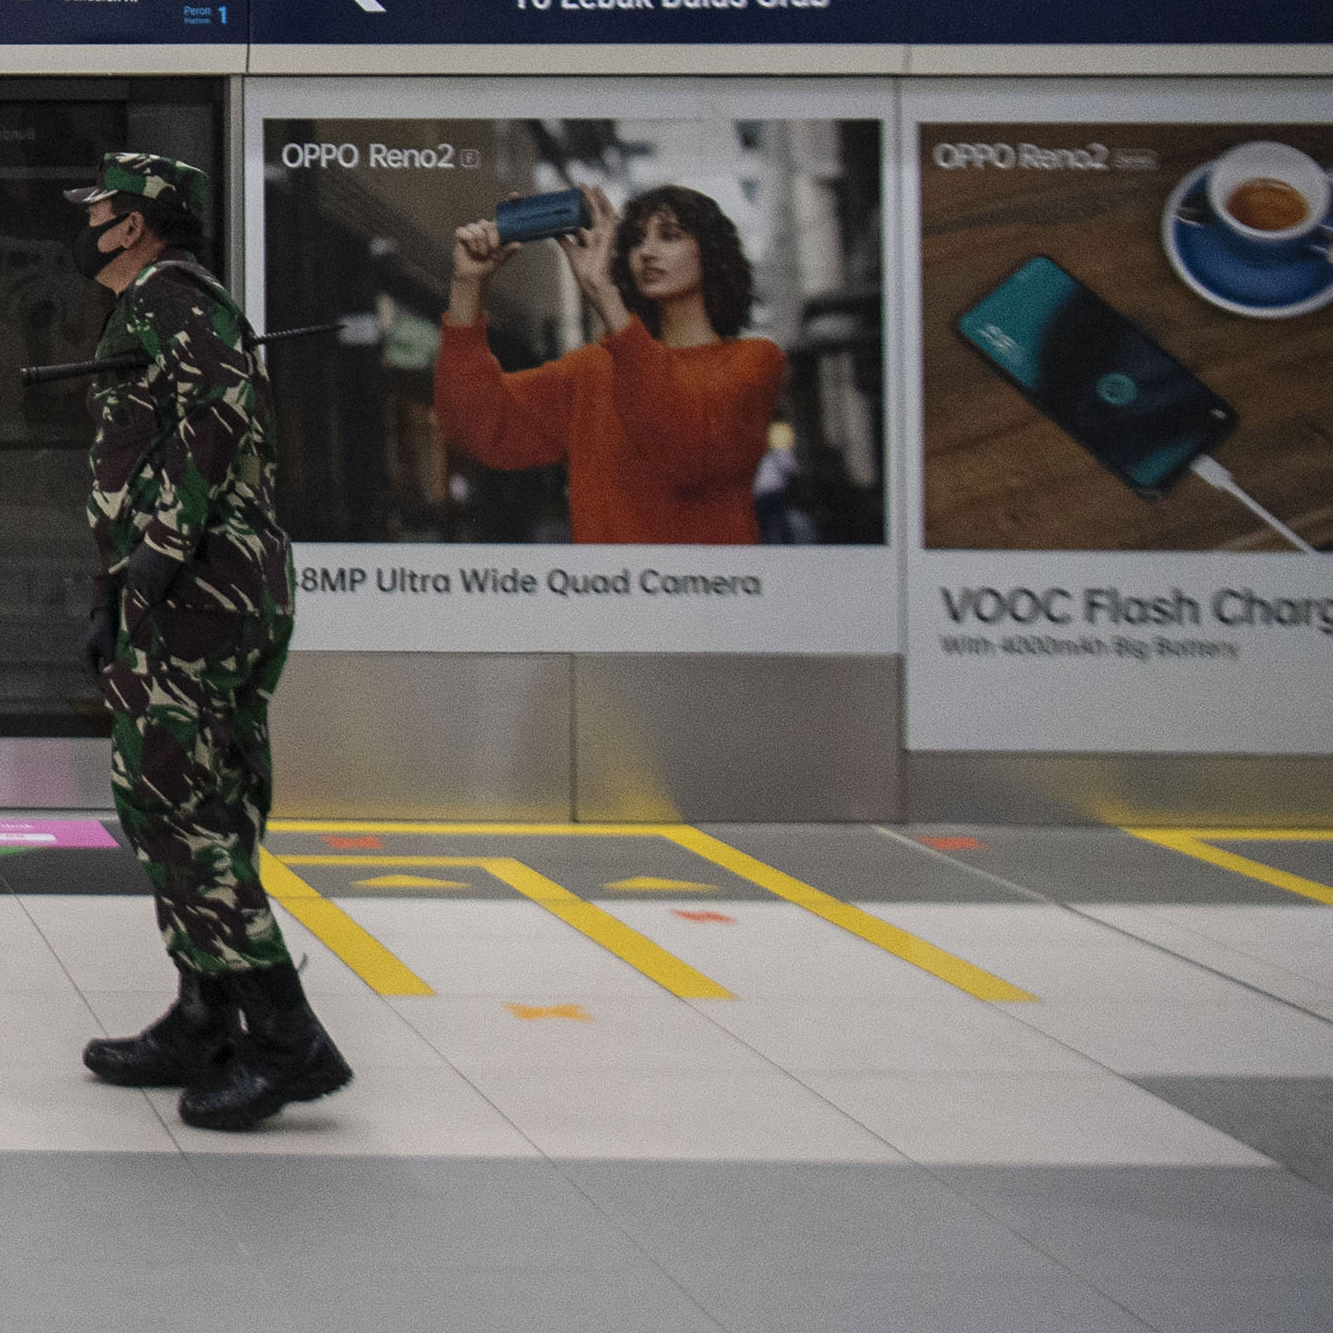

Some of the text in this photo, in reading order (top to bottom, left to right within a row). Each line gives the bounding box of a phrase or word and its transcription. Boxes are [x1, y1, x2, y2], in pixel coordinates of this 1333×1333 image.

[183, 5, 228, 25] Peron 1
[281, 143, 359, 168] OPPO
[369, 142, 455, 168] Reno2
[934, 142, 1016, 170] OPPO
[1017, 142, 1111, 171] Reno2
[296, 566, 762, 596] 8MP Ultra Wide Quad Camera
[941, 587, 1072, 625] VOOC
[1083, 587, 1201, 625] Flash
[939, 633, 996, 656] With
[1113, 636, 1150, 662] Big
